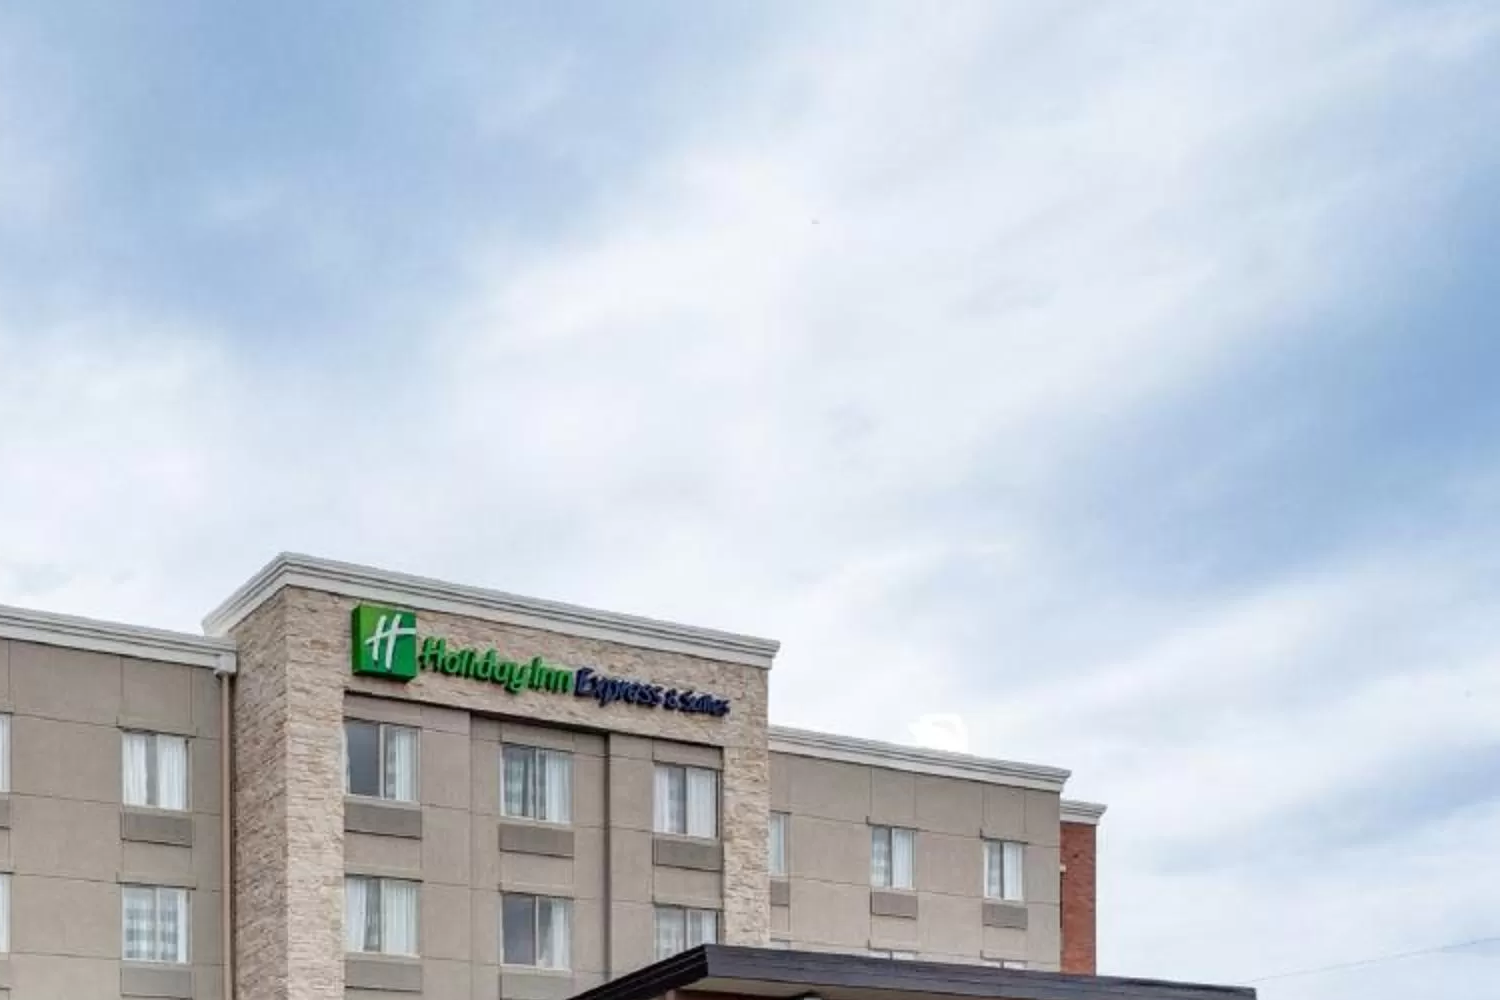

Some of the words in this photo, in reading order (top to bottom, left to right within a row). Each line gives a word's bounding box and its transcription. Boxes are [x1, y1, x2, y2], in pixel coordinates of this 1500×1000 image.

[418, 635, 528, 695] Holiday
[526, 655, 574, 694] Inn
[574, 667, 663, 708] Express
